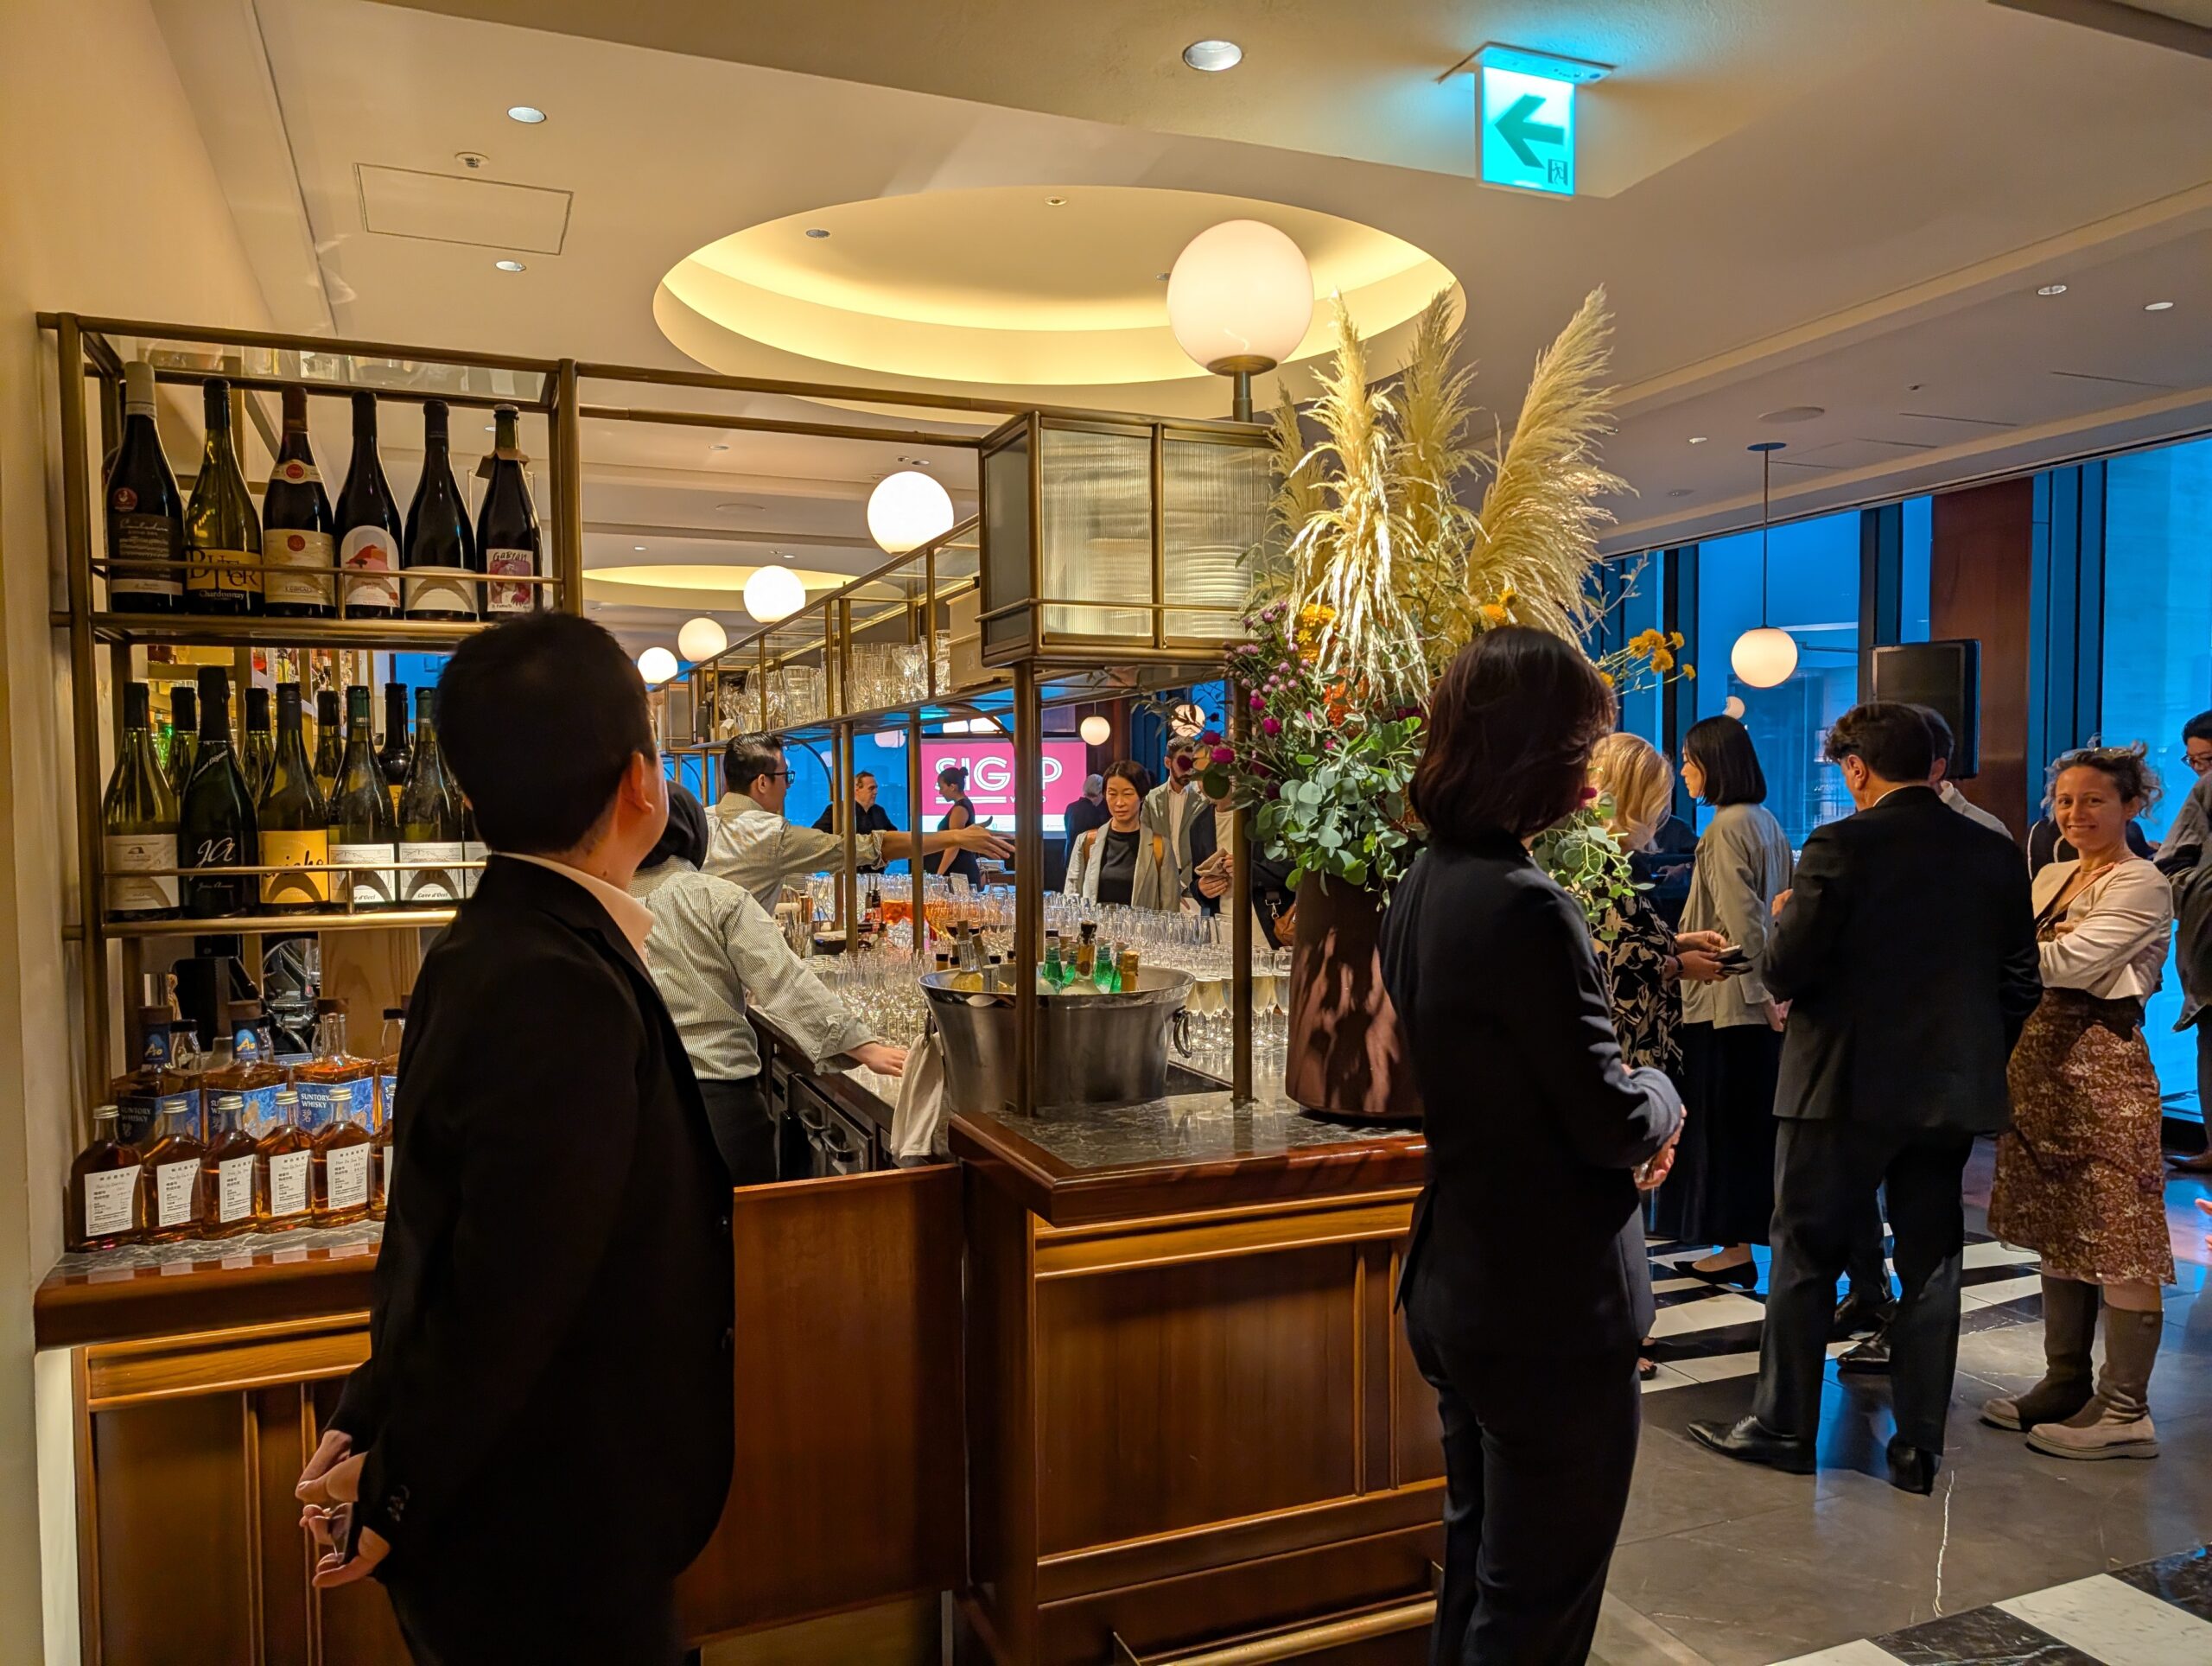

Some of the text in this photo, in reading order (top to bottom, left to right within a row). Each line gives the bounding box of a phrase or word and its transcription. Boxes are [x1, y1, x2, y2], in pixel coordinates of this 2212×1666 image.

[199, 589, 245, 600] Chardonnay
[935, 756, 1063, 792] SIGP
[145, 1043, 162, 1057] Ao
[237, 1038, 255, 1051] Ao
[301, 1093, 330, 1102] SUNTORY
[120, 1106, 152, 1116] SUNTORY
